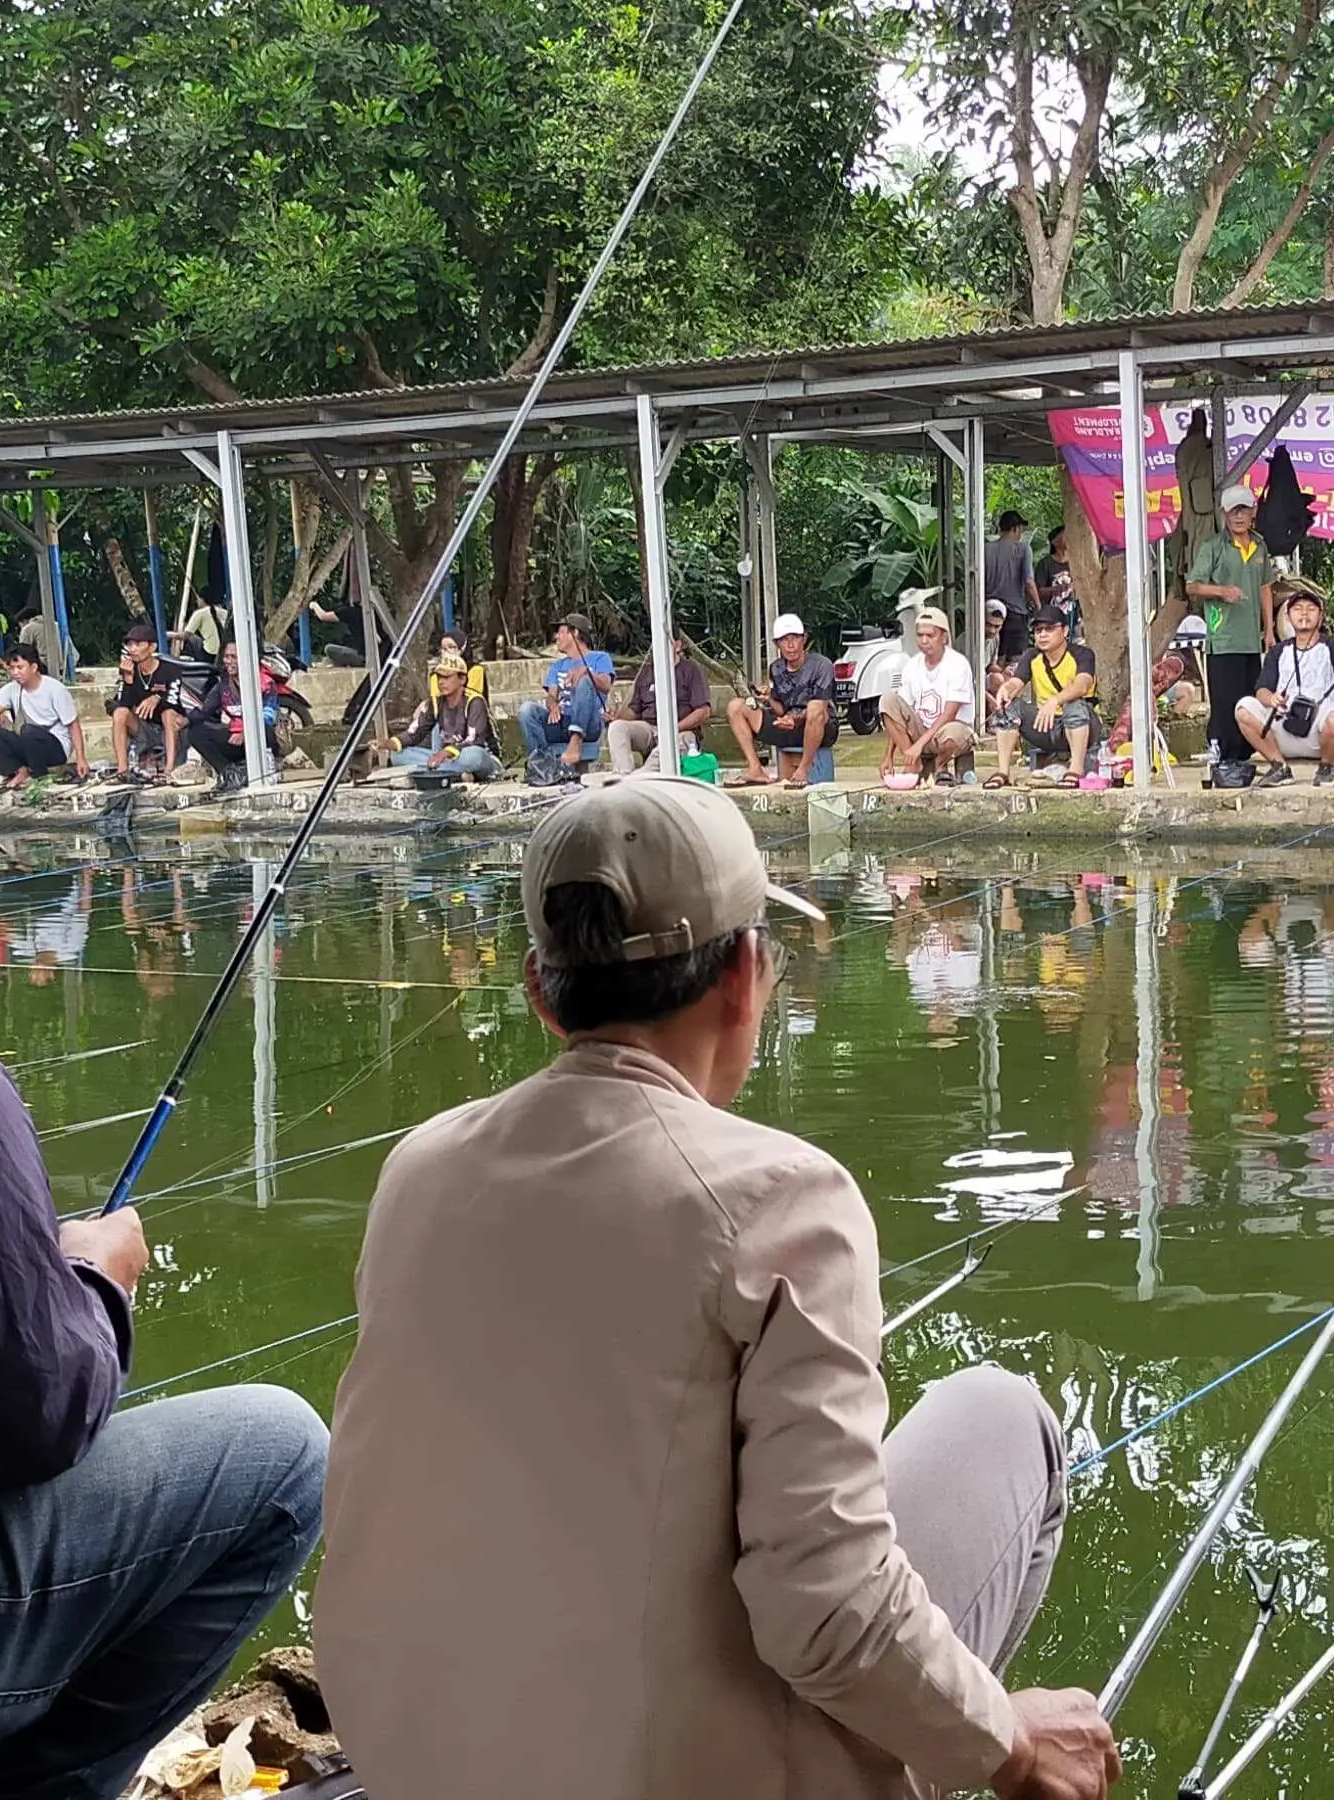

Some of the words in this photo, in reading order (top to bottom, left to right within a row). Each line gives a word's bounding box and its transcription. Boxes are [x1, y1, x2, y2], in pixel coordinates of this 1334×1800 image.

[752, 794, 768, 812] 20
[862, 793, 877, 812] 18
[1011, 795, 1026, 812] 16
